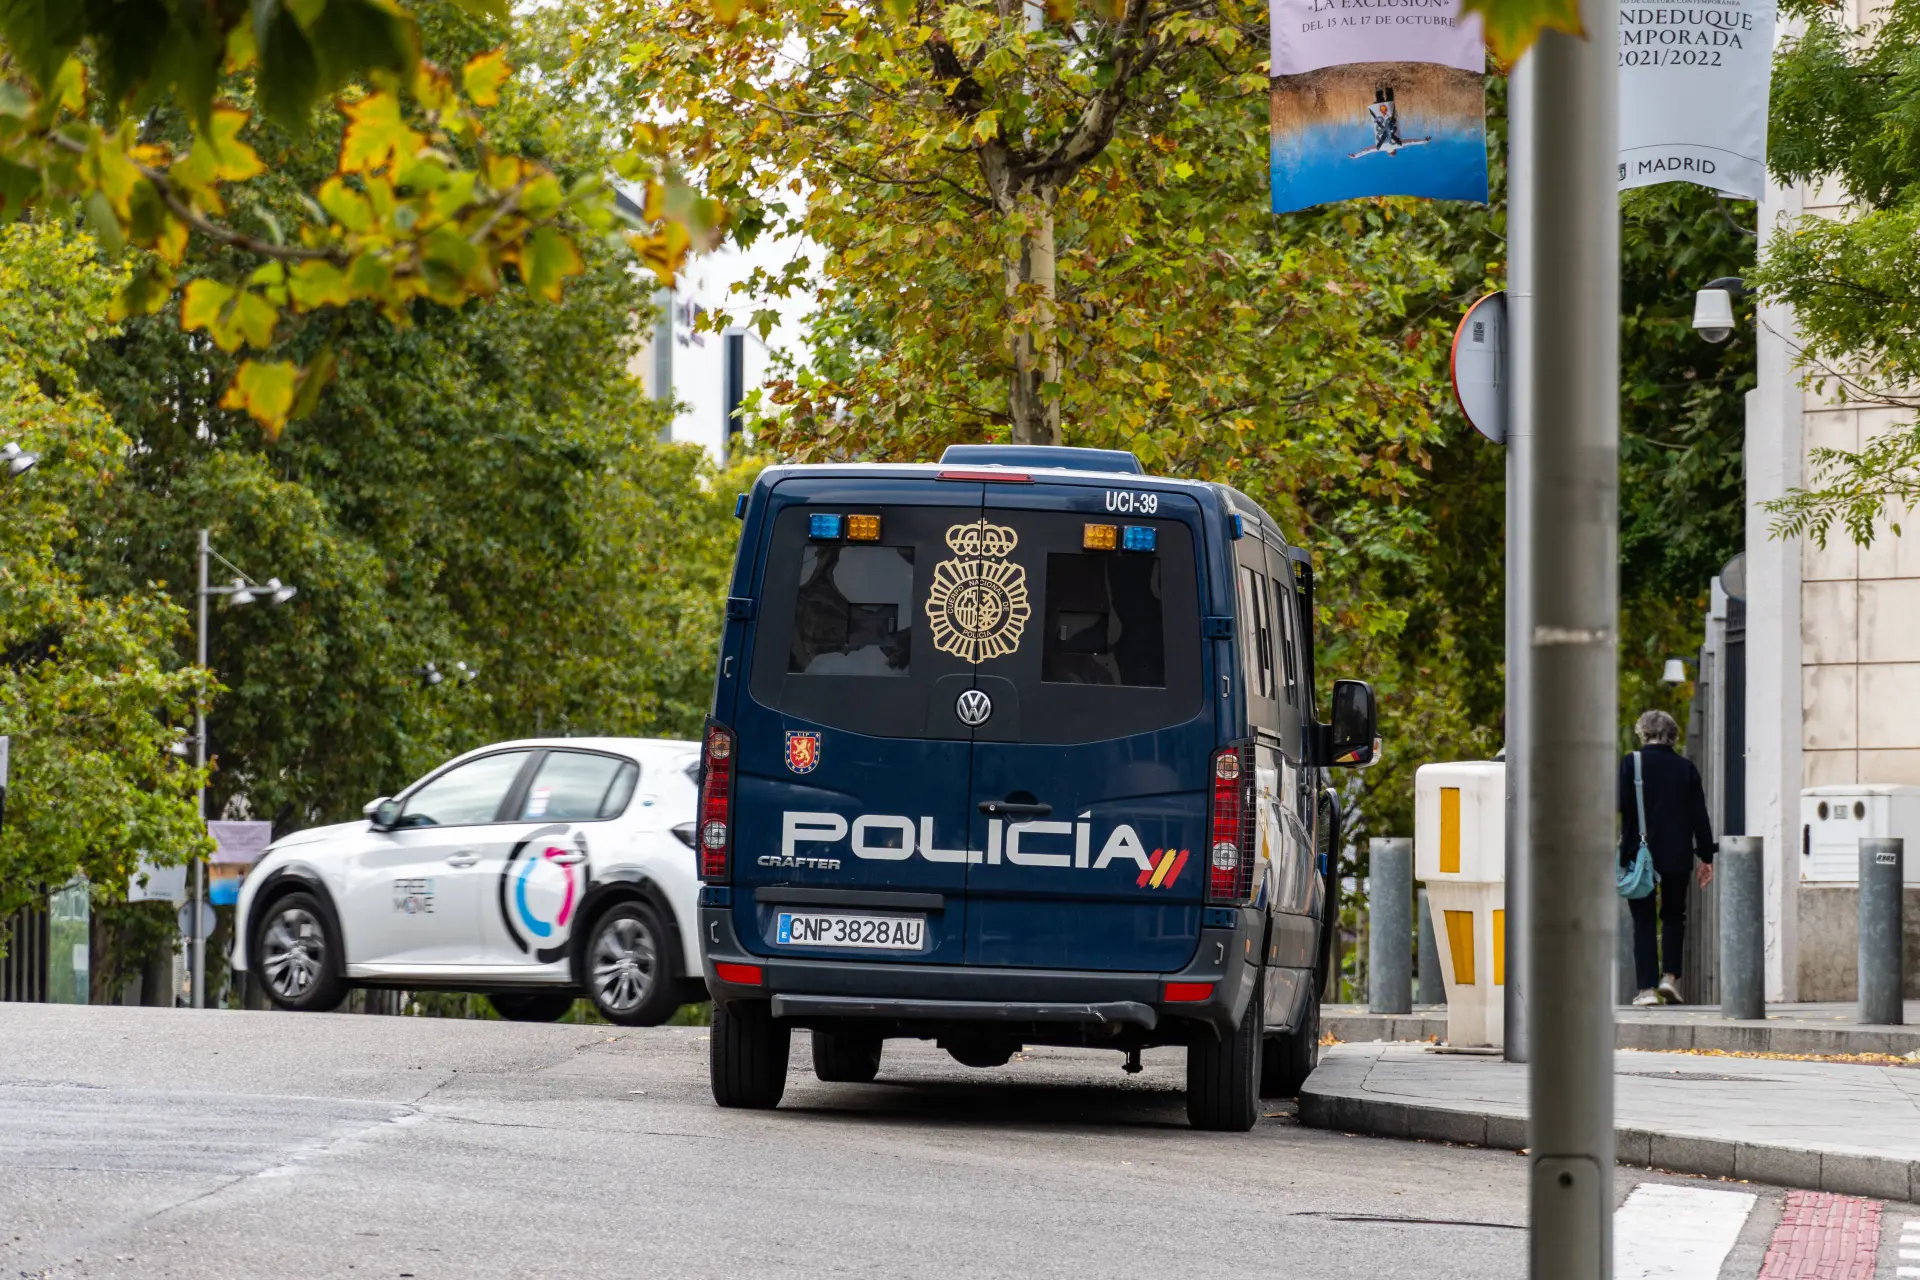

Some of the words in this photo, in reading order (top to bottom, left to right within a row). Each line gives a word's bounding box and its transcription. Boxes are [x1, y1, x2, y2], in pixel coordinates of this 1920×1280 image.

[1302, 19, 1324, 33] DEL
[1327, 17, 1337, 28] 15
[1340, 16, 1357, 27] AL
[1361, 16, 1371, 25] 17
[1375, 15, 1392, 25] DE
[1395, 15, 1456, 28] OCTUBRE
[1619, 29, 1743, 50] MPORADA
[1638, 157, 1716, 175] MADRID
[1105, 490, 1158, 514] UCI-39
[947, 585, 964, 614] CUERPO
[968, 580, 1004, 598] NACIONAL
[1002, 601, 1010, 612] DE
[781, 810, 1153, 871] POLICÍA
[757, 856, 841, 870] CRAFTER
